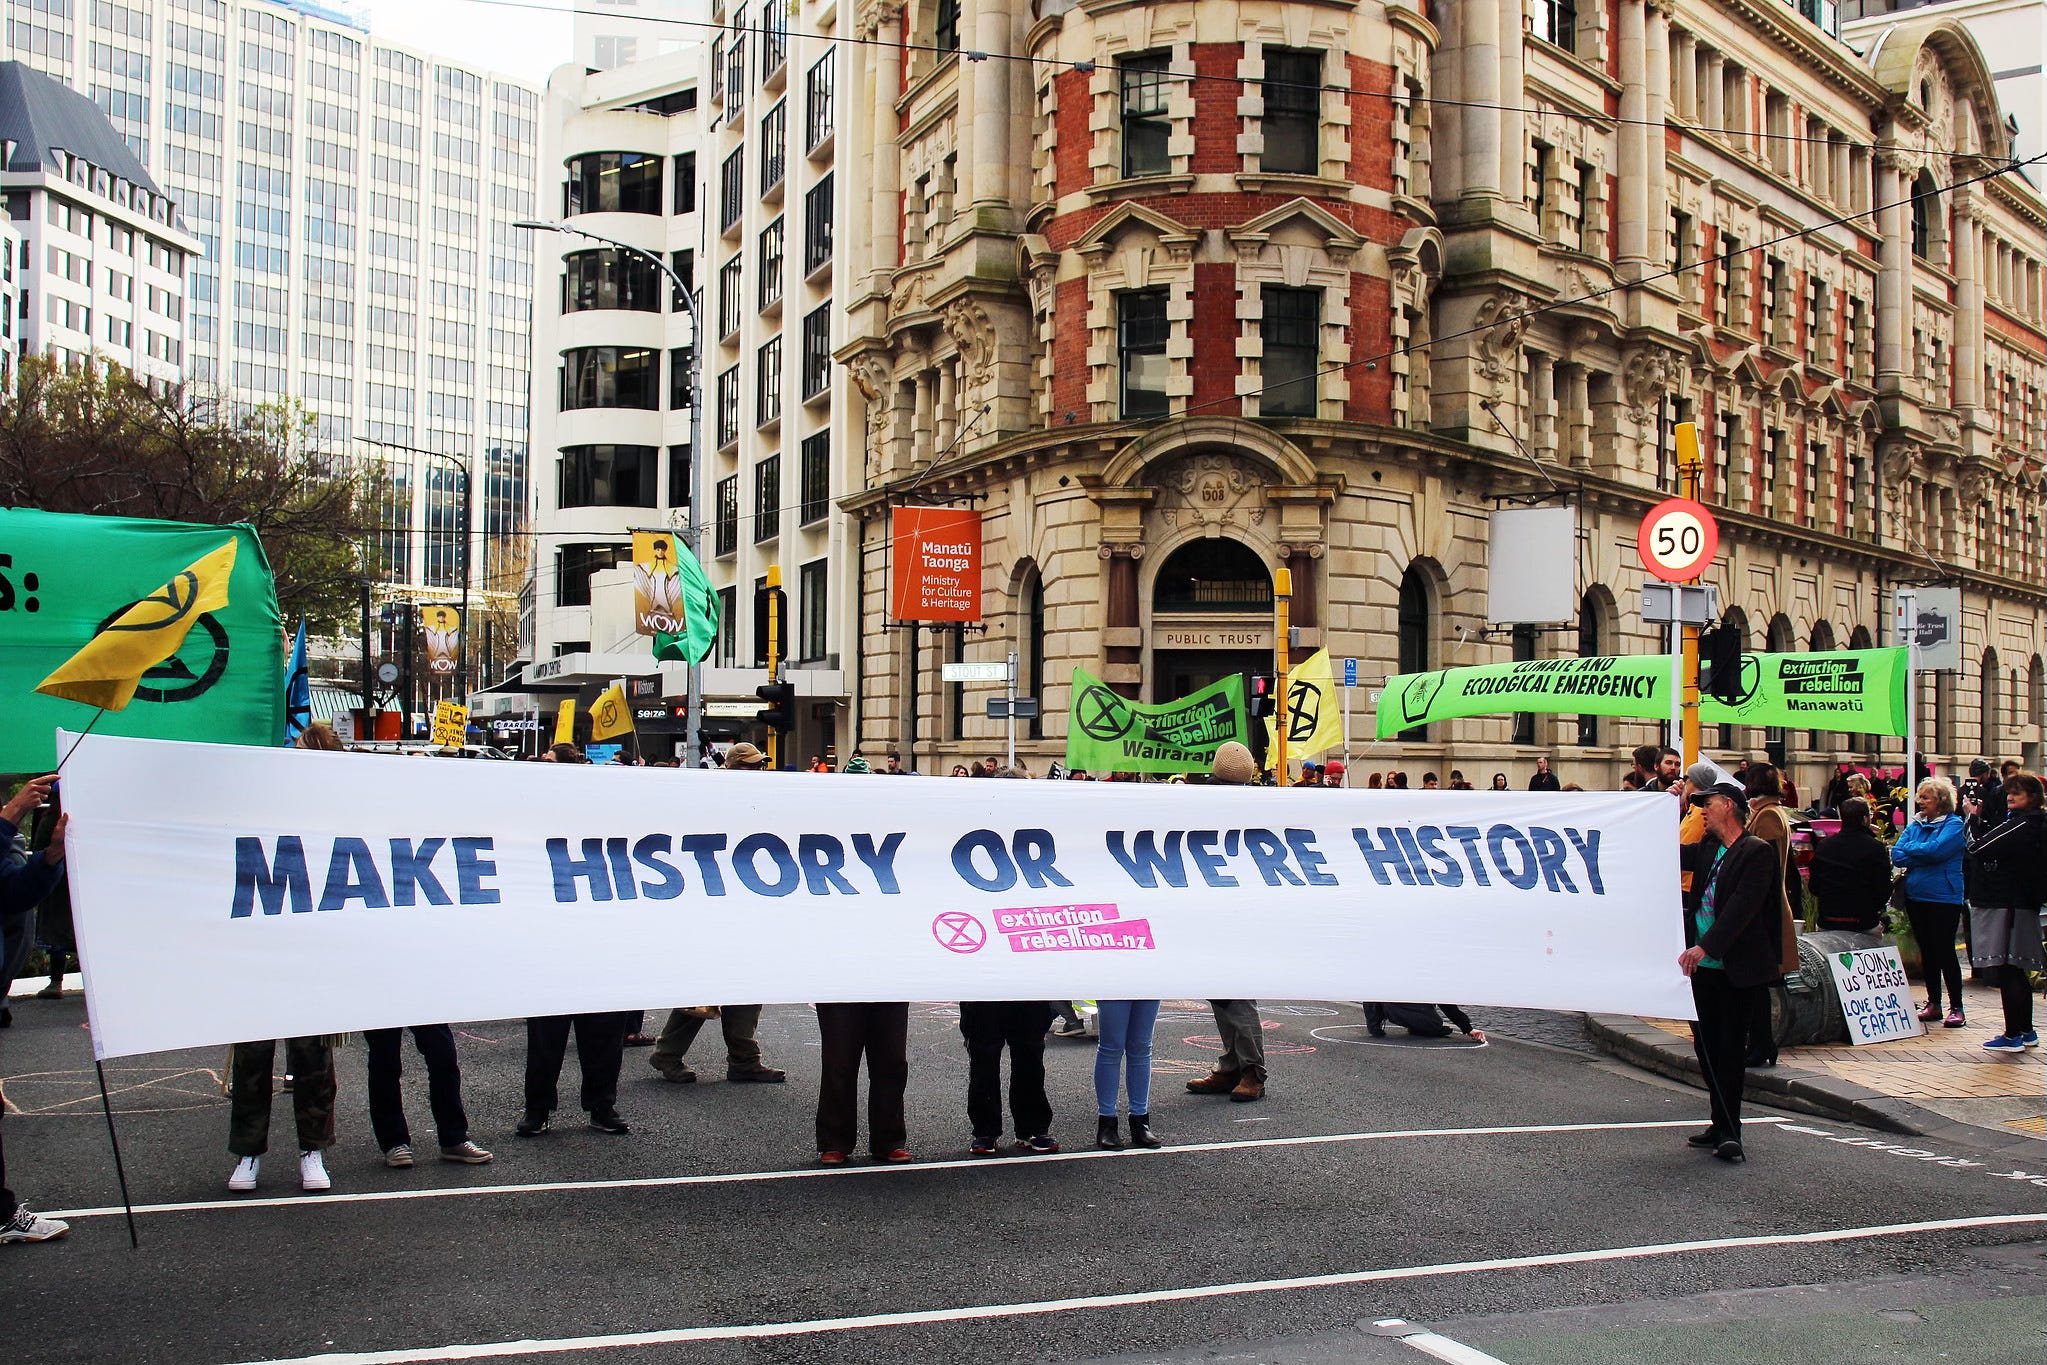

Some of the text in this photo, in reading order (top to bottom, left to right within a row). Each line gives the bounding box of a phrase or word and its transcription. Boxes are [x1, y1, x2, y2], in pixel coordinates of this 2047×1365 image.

[1202, 489, 1224, 502] 1908
[922, 542, 972, 555] Manatū
[1658, 526, 1699, 555] 50
[922, 555, 969, 572] Taonga
[922, 575, 960, 587] Ministry
[921, 586, 972, 598] for Culture
[921, 598, 971, 611] & Heritage
[640, 612, 684, 632] WOW
[1167, 634, 1262, 644] PUBLIC TRUST
[430, 659, 458, 671] WOW
[951, 666, 998, 678] STOUT ST
[1513, 657, 1617, 673] CLIMATE AND
[1783, 660, 1848, 675] extinction
[1462, 674, 1657, 699] ECOLOGICAL EMERGENCY
[1799, 673, 1860, 692] rebellion
[638, 709, 666, 718] seize
[1786, 699, 1864, 712] Manawatū
[1122, 739, 1217, 766] Wairarap
[231, 824, 1606, 919] MAKE HISTORY OR WE'RE HISTORY
[1001, 906, 1103, 928] extinction
[1020, 927, 1148, 949] rebellion.nz
[1853, 952, 1889, 975] JOIN
[1842, 970, 1906, 992] US PLEASE
[1844, 993, 1901, 1017] LOVE OUR
[1859, 1009, 1911, 1038] EARTH
